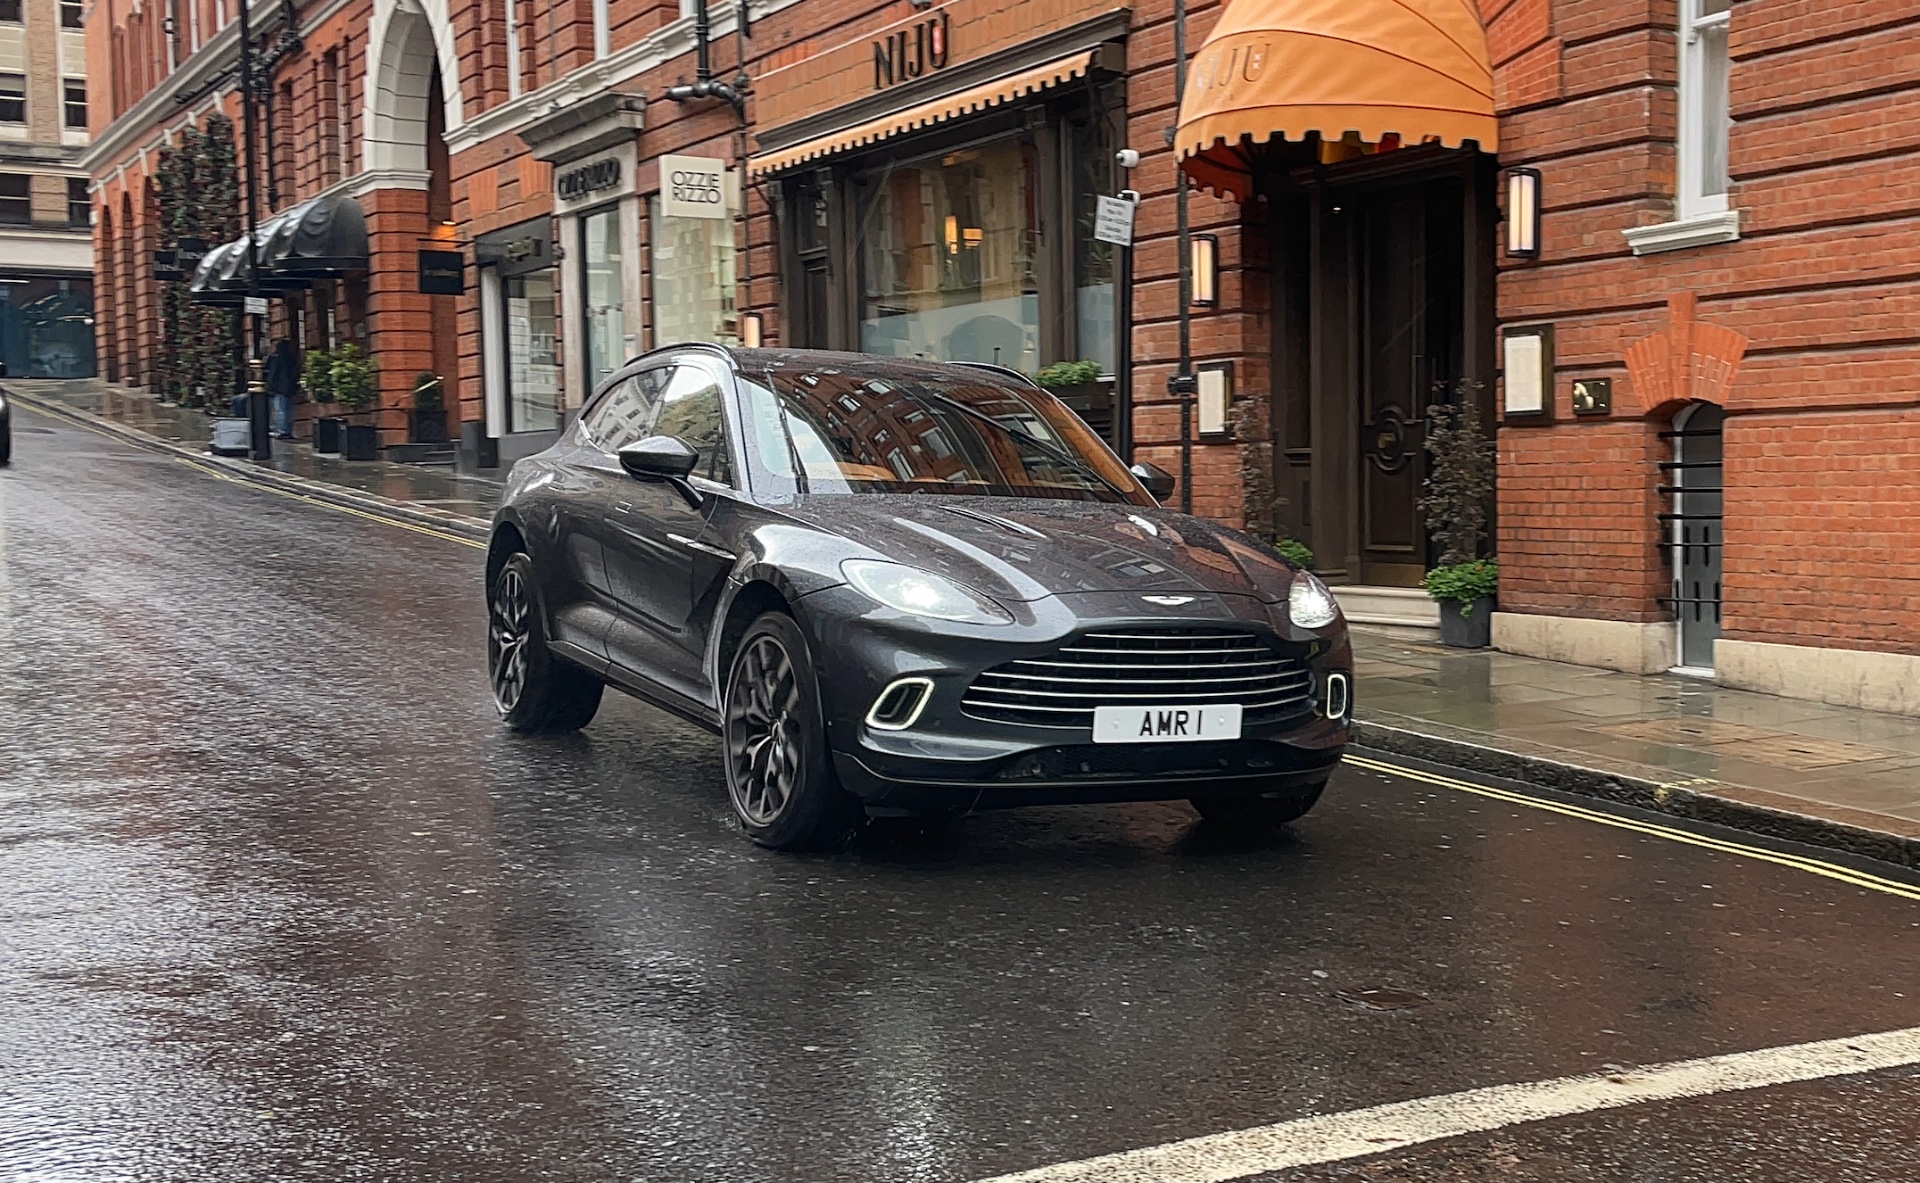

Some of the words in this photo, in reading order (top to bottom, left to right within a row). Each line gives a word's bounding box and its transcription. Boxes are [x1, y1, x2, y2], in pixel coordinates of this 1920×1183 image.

[670, 170, 720, 188] OZZIE
[671, 186, 722, 204] RIZZO
[1139, 710, 1189, 736] AMR
